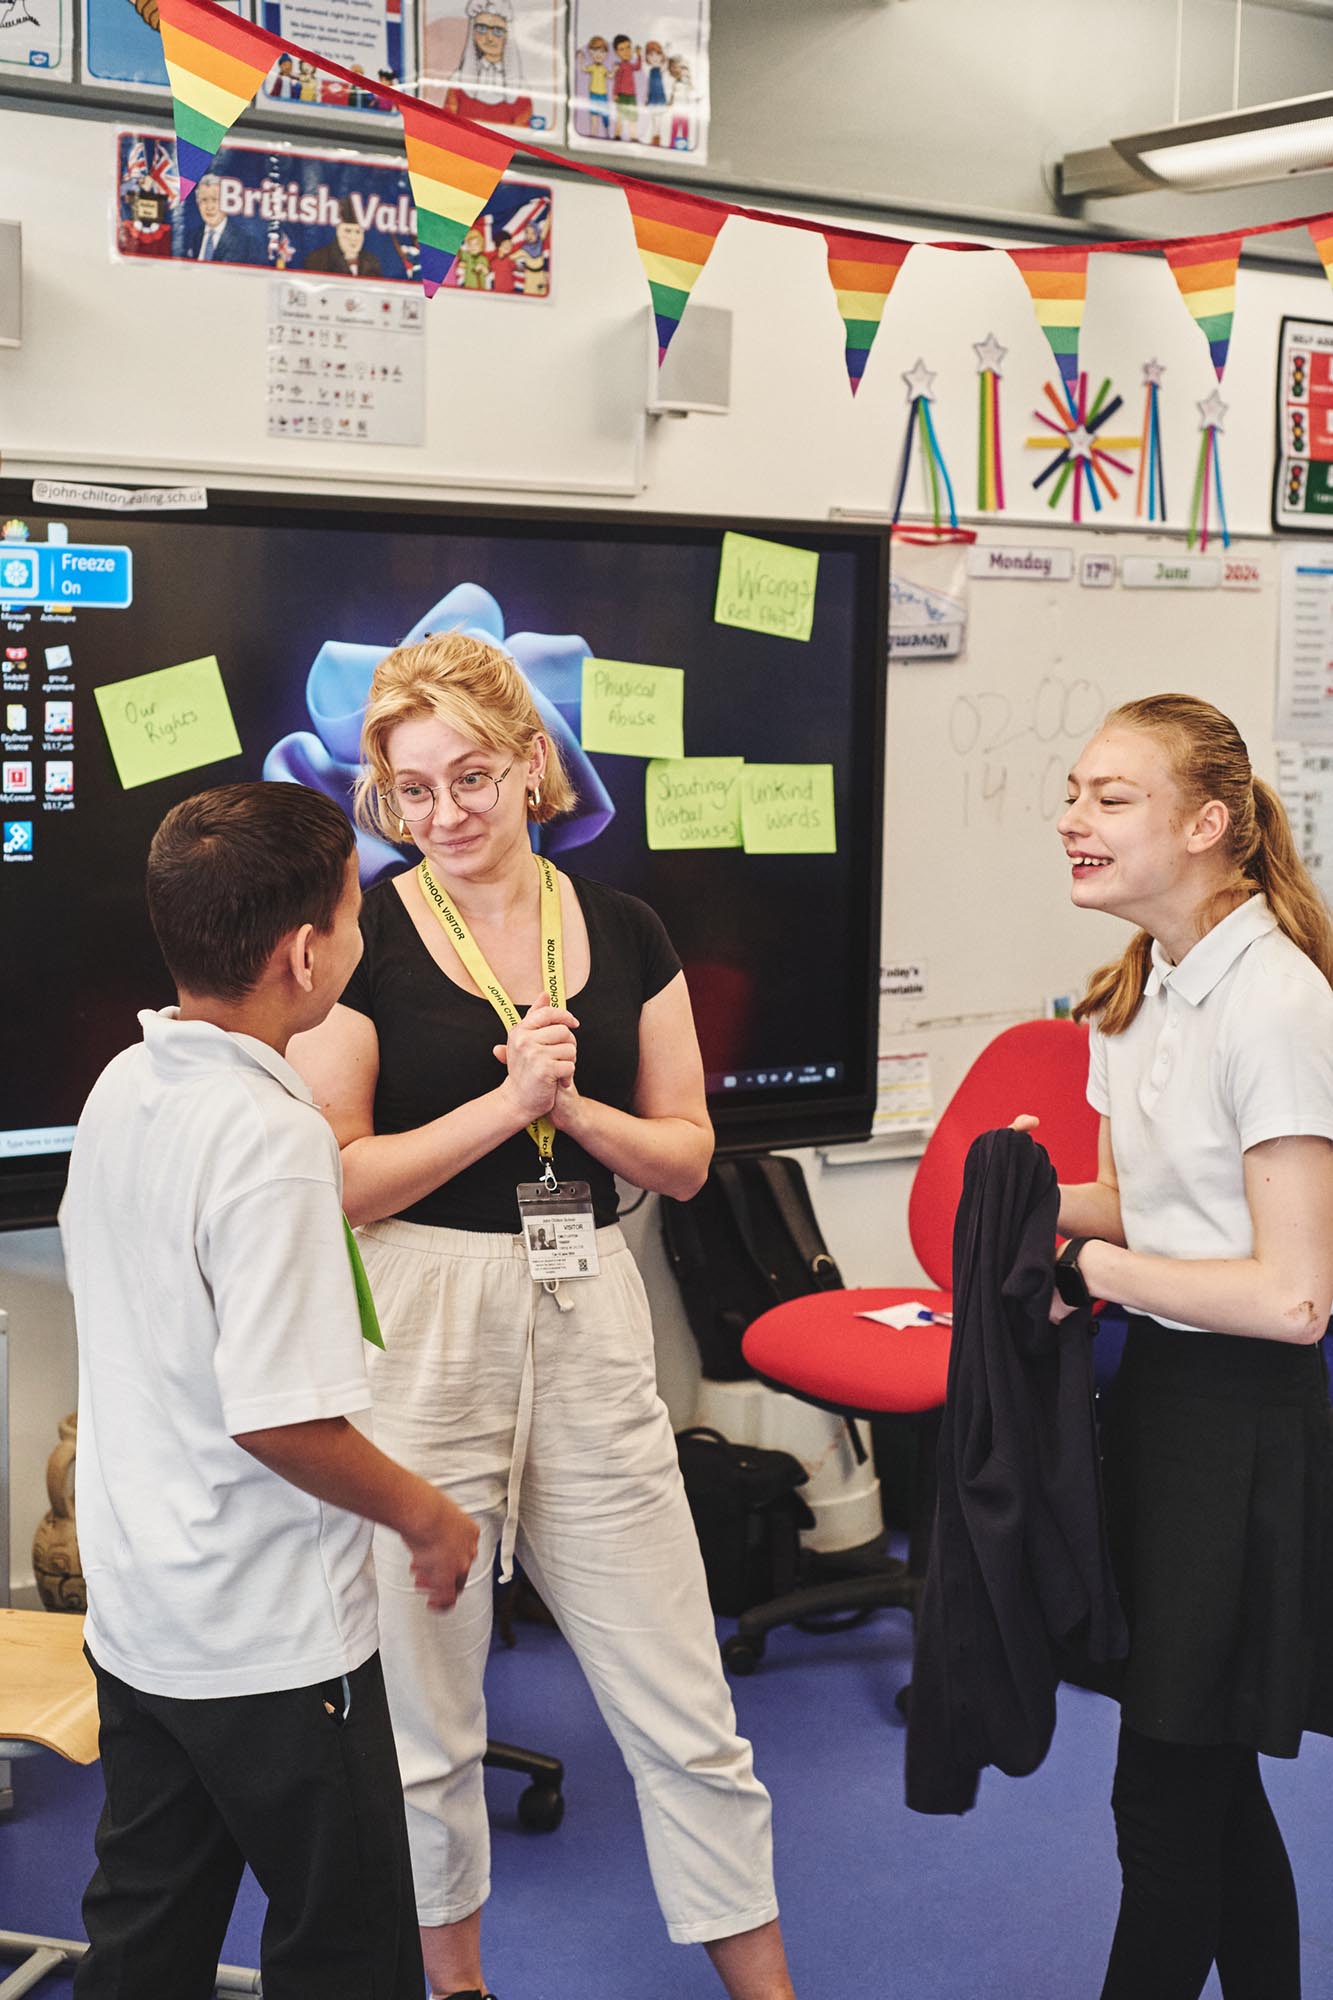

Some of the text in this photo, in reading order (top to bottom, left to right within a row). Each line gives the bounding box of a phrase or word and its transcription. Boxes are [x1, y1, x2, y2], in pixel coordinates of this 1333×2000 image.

[219, 176, 341, 226] British
[61, 553, 116, 573] Freeze
[988, 553, 1052, 575] Monday
[1154, 563, 1190, 580] June
[1223, 564, 1260, 582] 2024
[61, 580, 82, 596] On
[124, 701, 157, 725] Our
[145, 710, 199, 745] Rights
[546, 869, 554, 892] JOHN
[423, 871, 465, 941] SCHOOL VISITOR
[547, 939, 559, 1008] SCHOOL VISITOR
[487, 984, 508, 1007] JOHN
